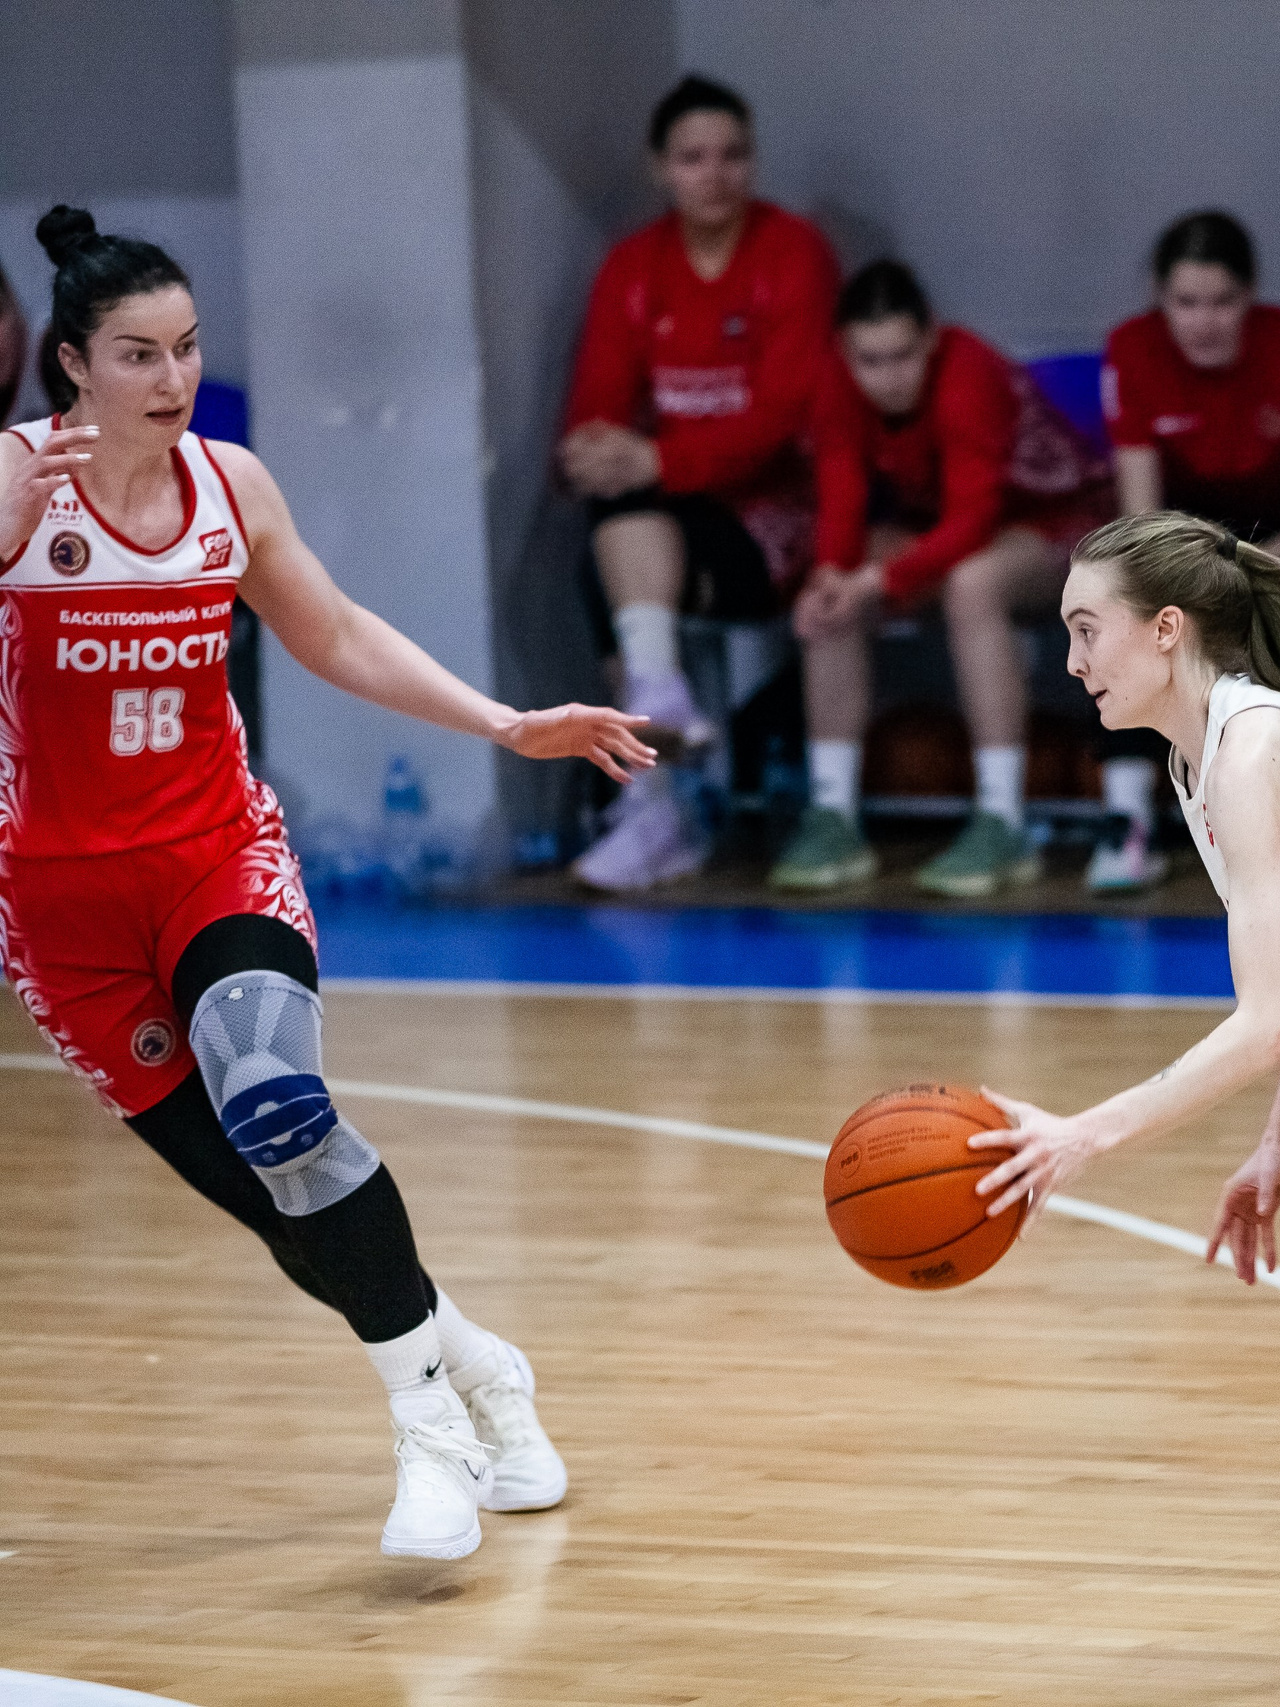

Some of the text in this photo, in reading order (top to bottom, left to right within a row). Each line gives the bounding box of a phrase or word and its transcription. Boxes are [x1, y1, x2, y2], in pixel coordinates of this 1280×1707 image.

[59, 605, 197, 626] БАСКЕТБОЛЬНЫЙ
[56, 629, 229, 673] ЮНОСТЬ
[109, 686, 186, 756] 58
